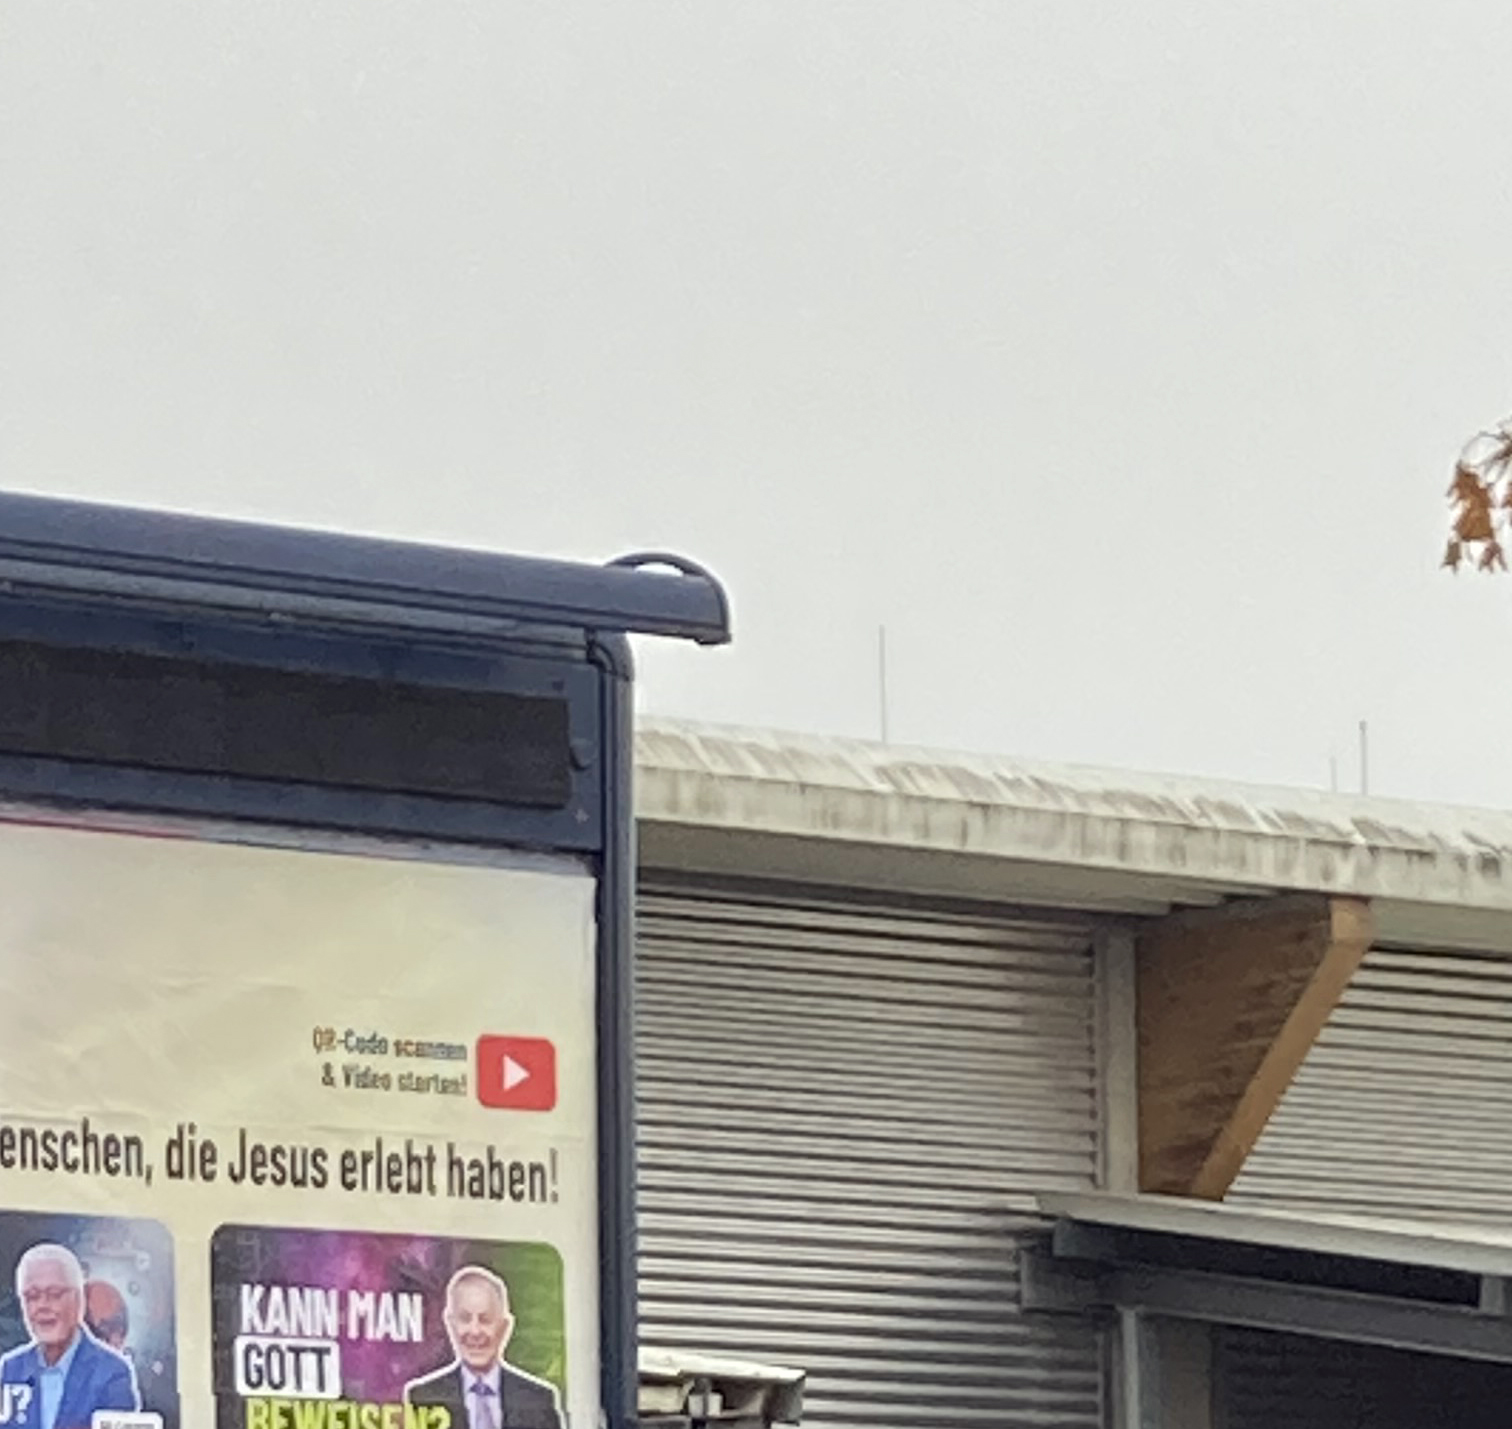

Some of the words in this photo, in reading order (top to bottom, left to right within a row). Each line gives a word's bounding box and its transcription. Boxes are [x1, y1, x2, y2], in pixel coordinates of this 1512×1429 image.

[165, 1120, 219, 1182] die
[228, 1127, 329, 1190] Jesus
[340, 1136, 438, 1197] erlebt
[447, 1141, 559, 1204] haben!
[240, 1283, 339, 1338] KANN
[347, 1289, 424, 1343] MAN
[243, 1343, 332, 1393] GOTT
